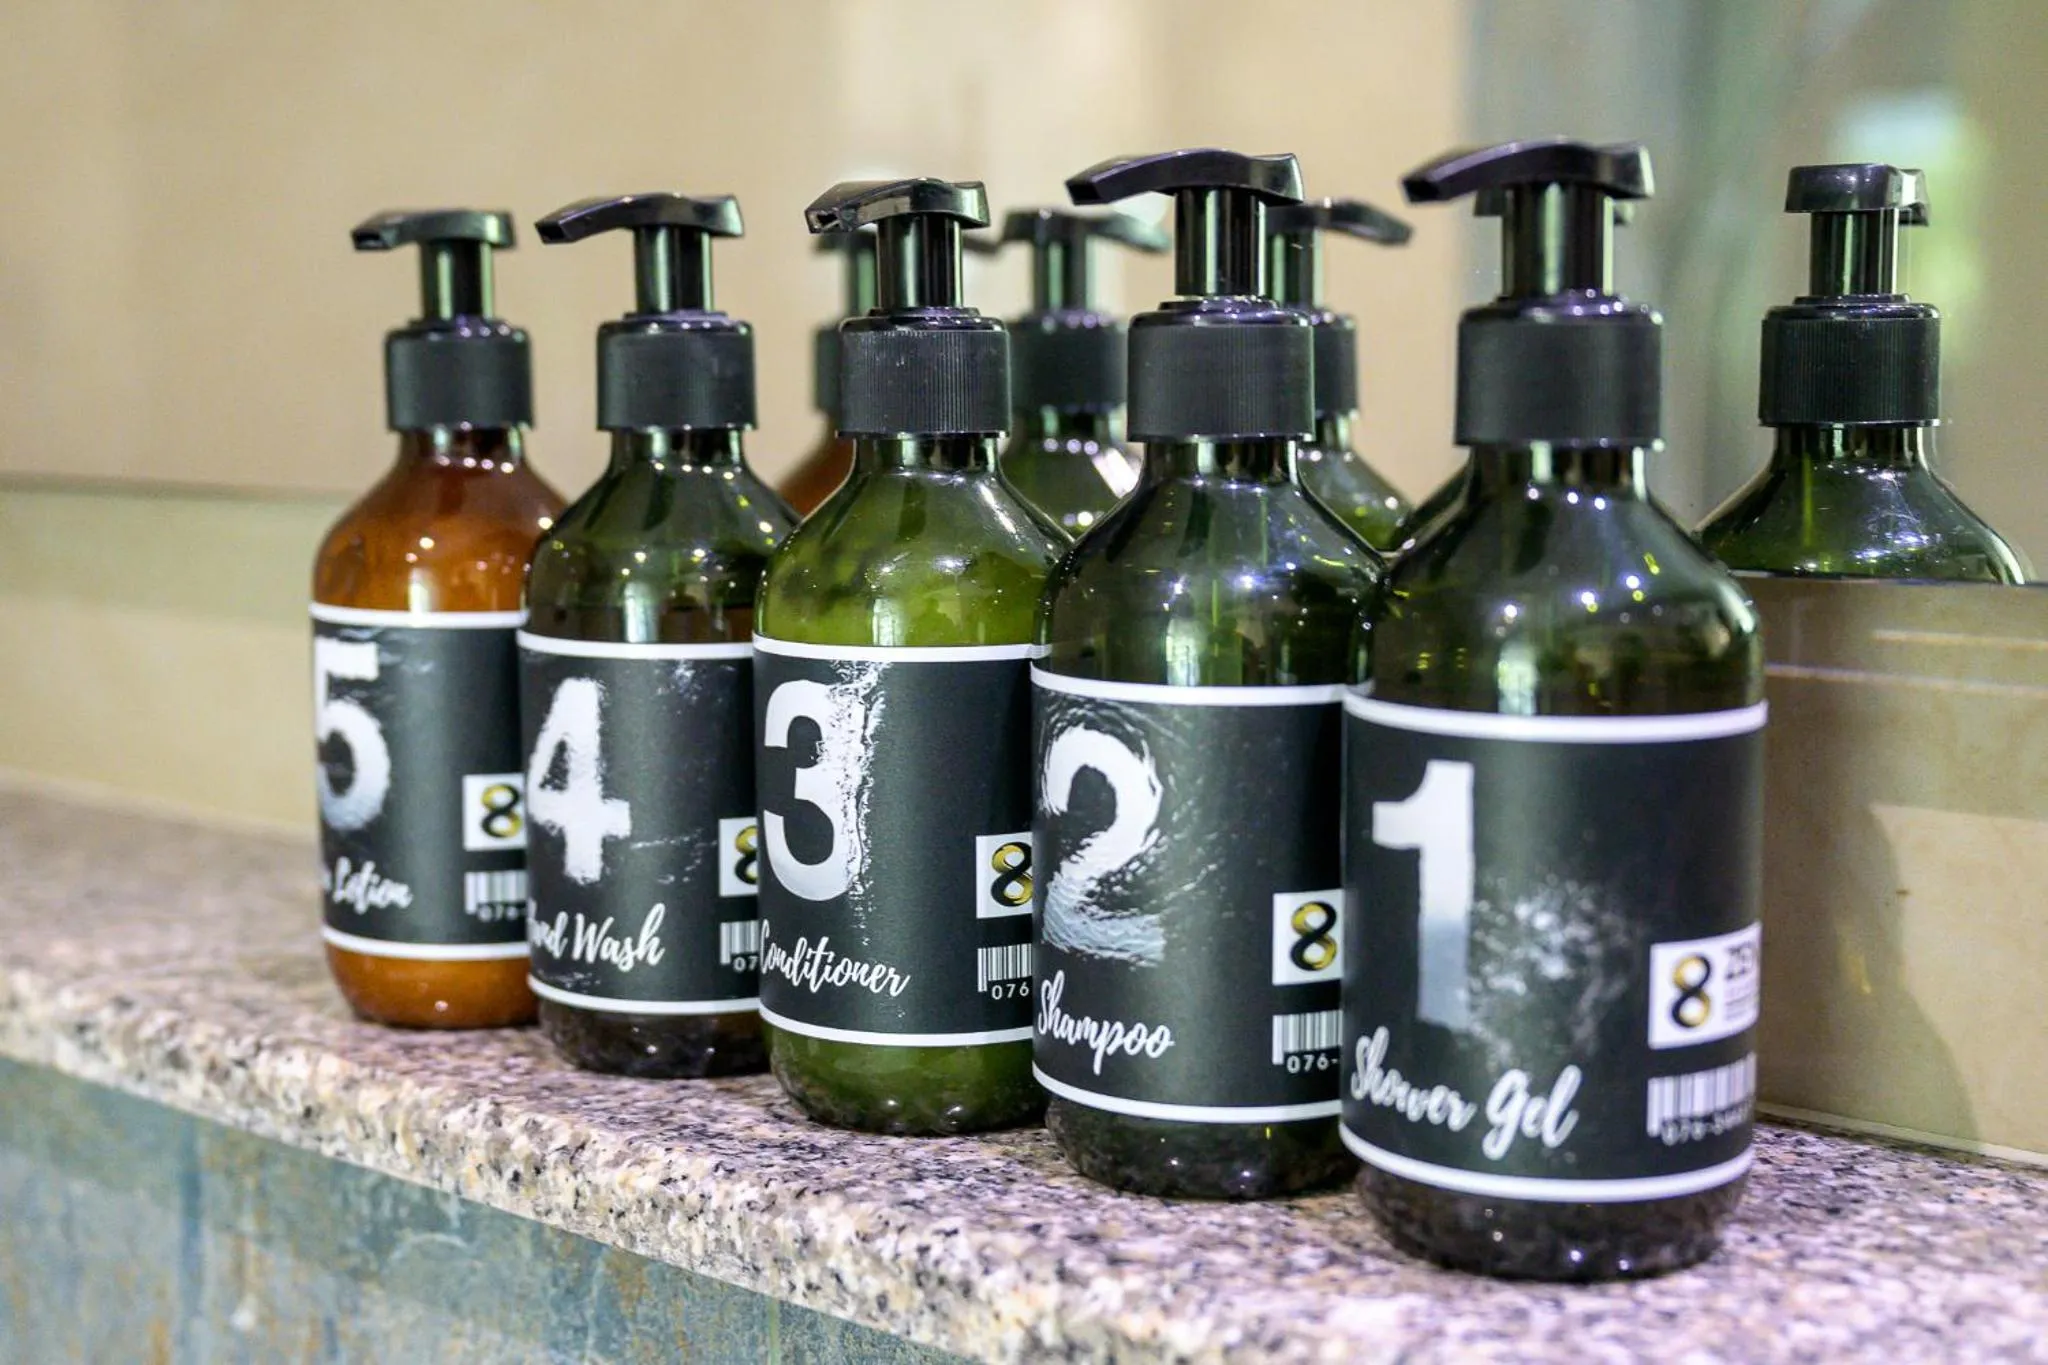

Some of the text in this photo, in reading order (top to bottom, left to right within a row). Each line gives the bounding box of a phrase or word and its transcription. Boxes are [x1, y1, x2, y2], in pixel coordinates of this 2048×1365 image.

[312, 636, 392, 832] 5
[481, 783, 521, 839] 8
[528, 677, 632, 884] 4
[763, 679, 878, 902] 3
[991, 841, 1033, 907] 8
[1040, 721, 1165, 968] 2
[332, 856, 413, 915] Lotion
[1372, 759, 1474, 1030] 1
[572, 903, 666, 973] Wash
[759, 918, 911, 996] Conditioner
[1290, 901, 1337, 971] 8
[991, 981, 1030, 1000] 076
[1037, 970, 1175, 1075] Shampoo
[1670, 954, 1711, 1029] 8
[1286, 1053, 1339, 1074] 076-
[1351, 1026, 1582, 1161] Shower Gel
